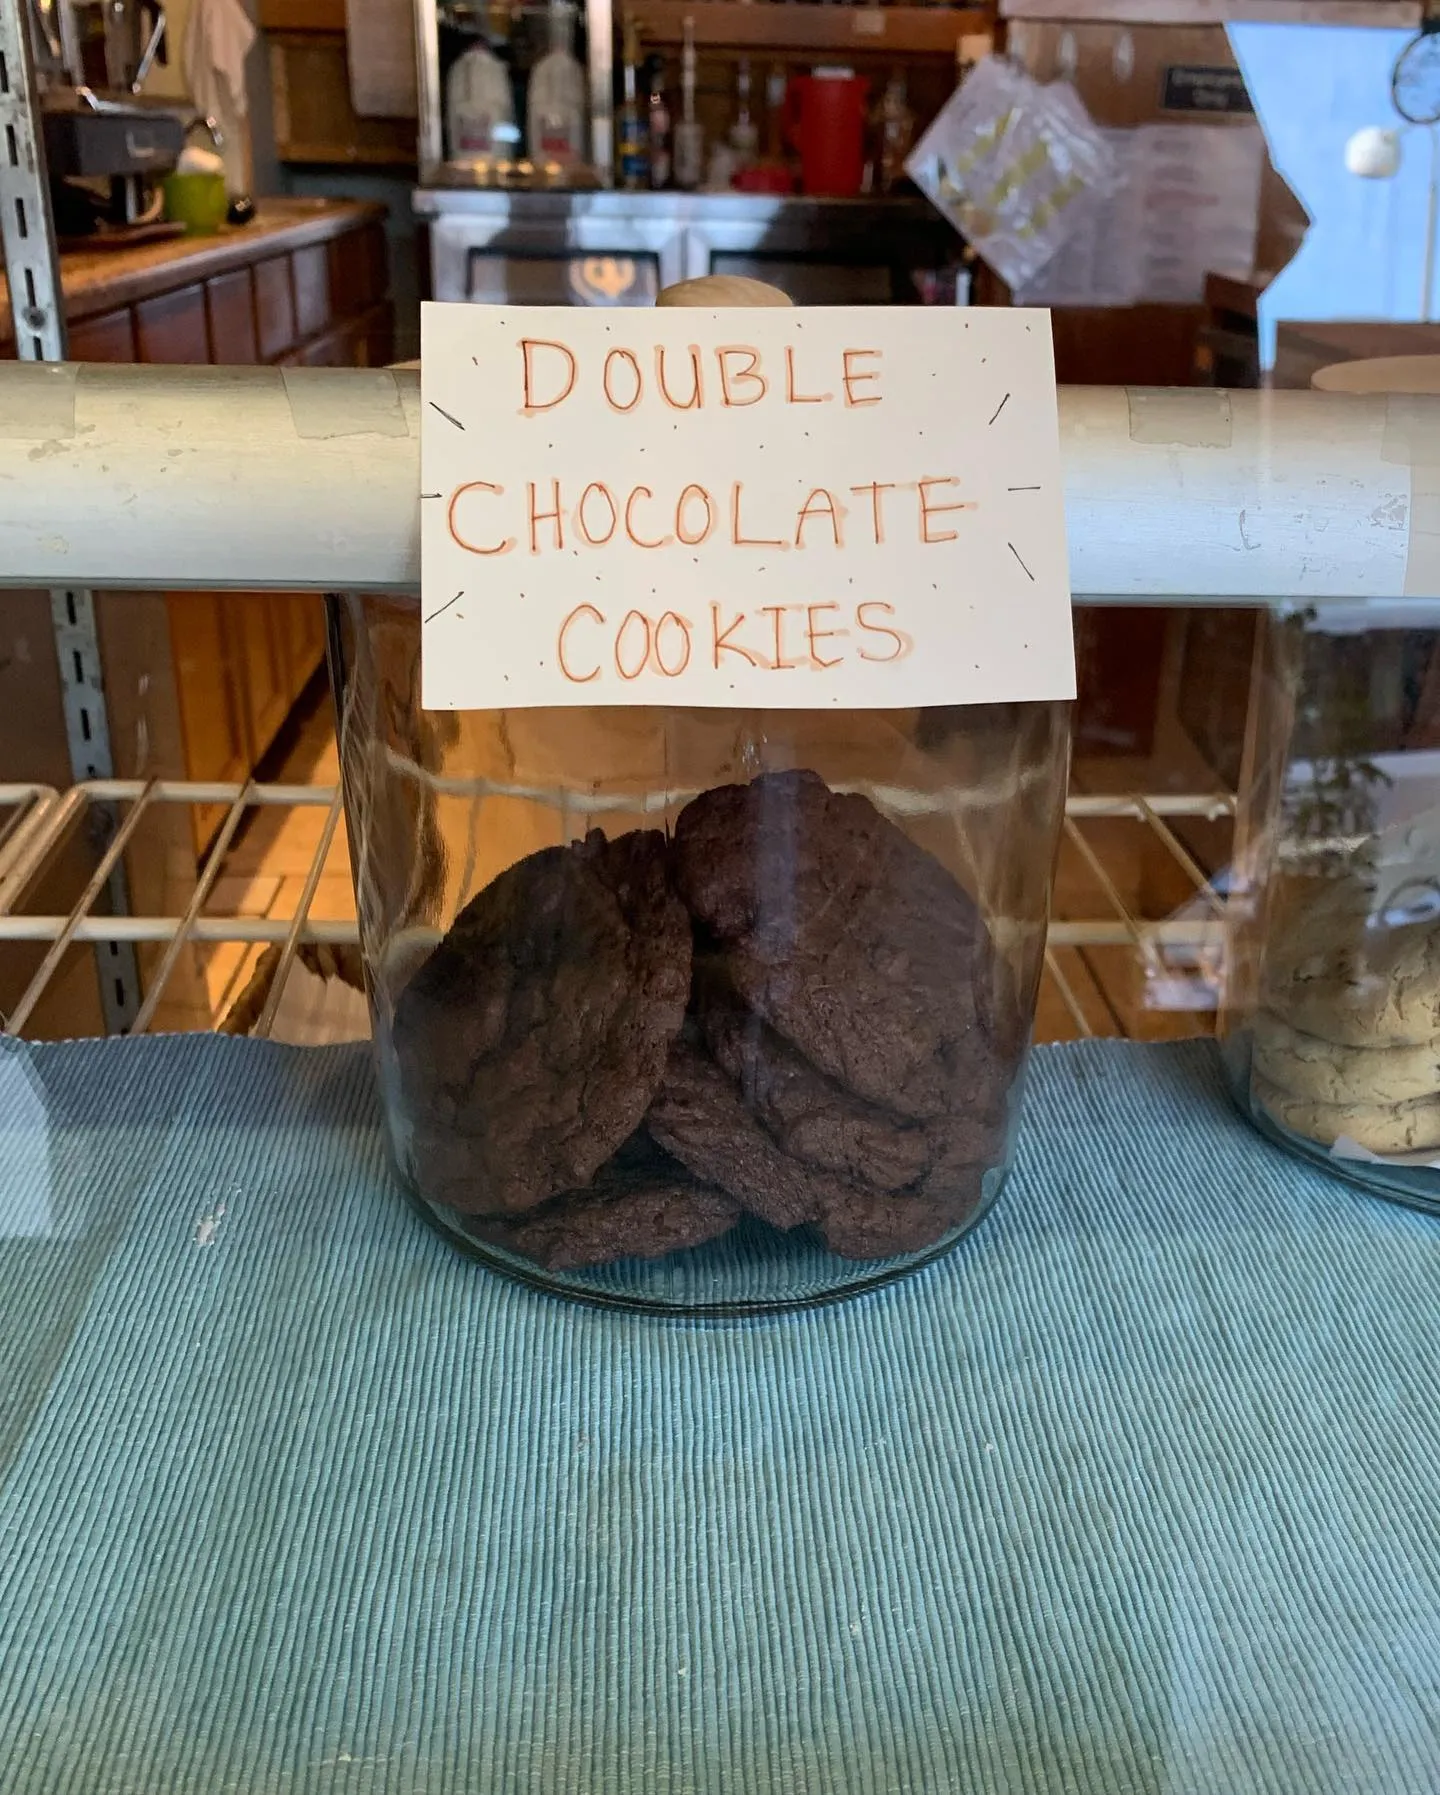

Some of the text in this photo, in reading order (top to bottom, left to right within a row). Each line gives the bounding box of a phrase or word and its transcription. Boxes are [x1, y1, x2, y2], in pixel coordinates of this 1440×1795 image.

[518, 339, 886, 415] DOUBLE
[447, 476, 976, 555] CHOCOLATE
[557, 601, 912, 684] COOKIES
